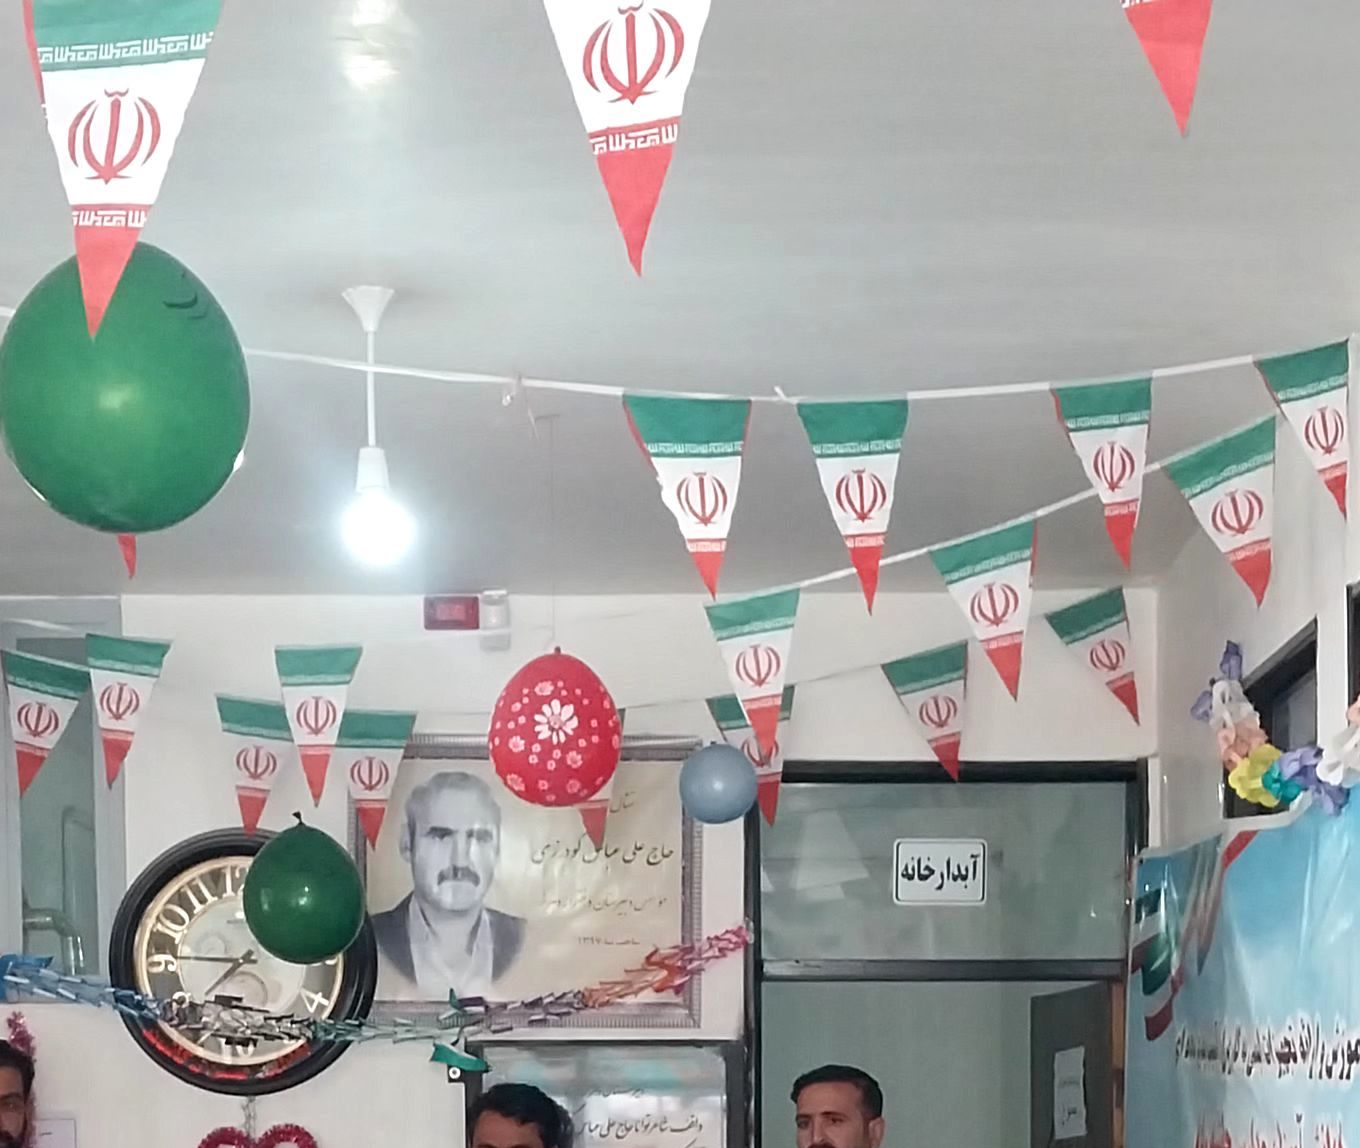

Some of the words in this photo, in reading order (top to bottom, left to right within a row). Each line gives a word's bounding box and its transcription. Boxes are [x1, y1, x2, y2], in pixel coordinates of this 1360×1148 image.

[621, 840, 644, 864] علی
[645, 841, 675, 866] حاج
[900, 852, 981, 892] آبدارخانه
